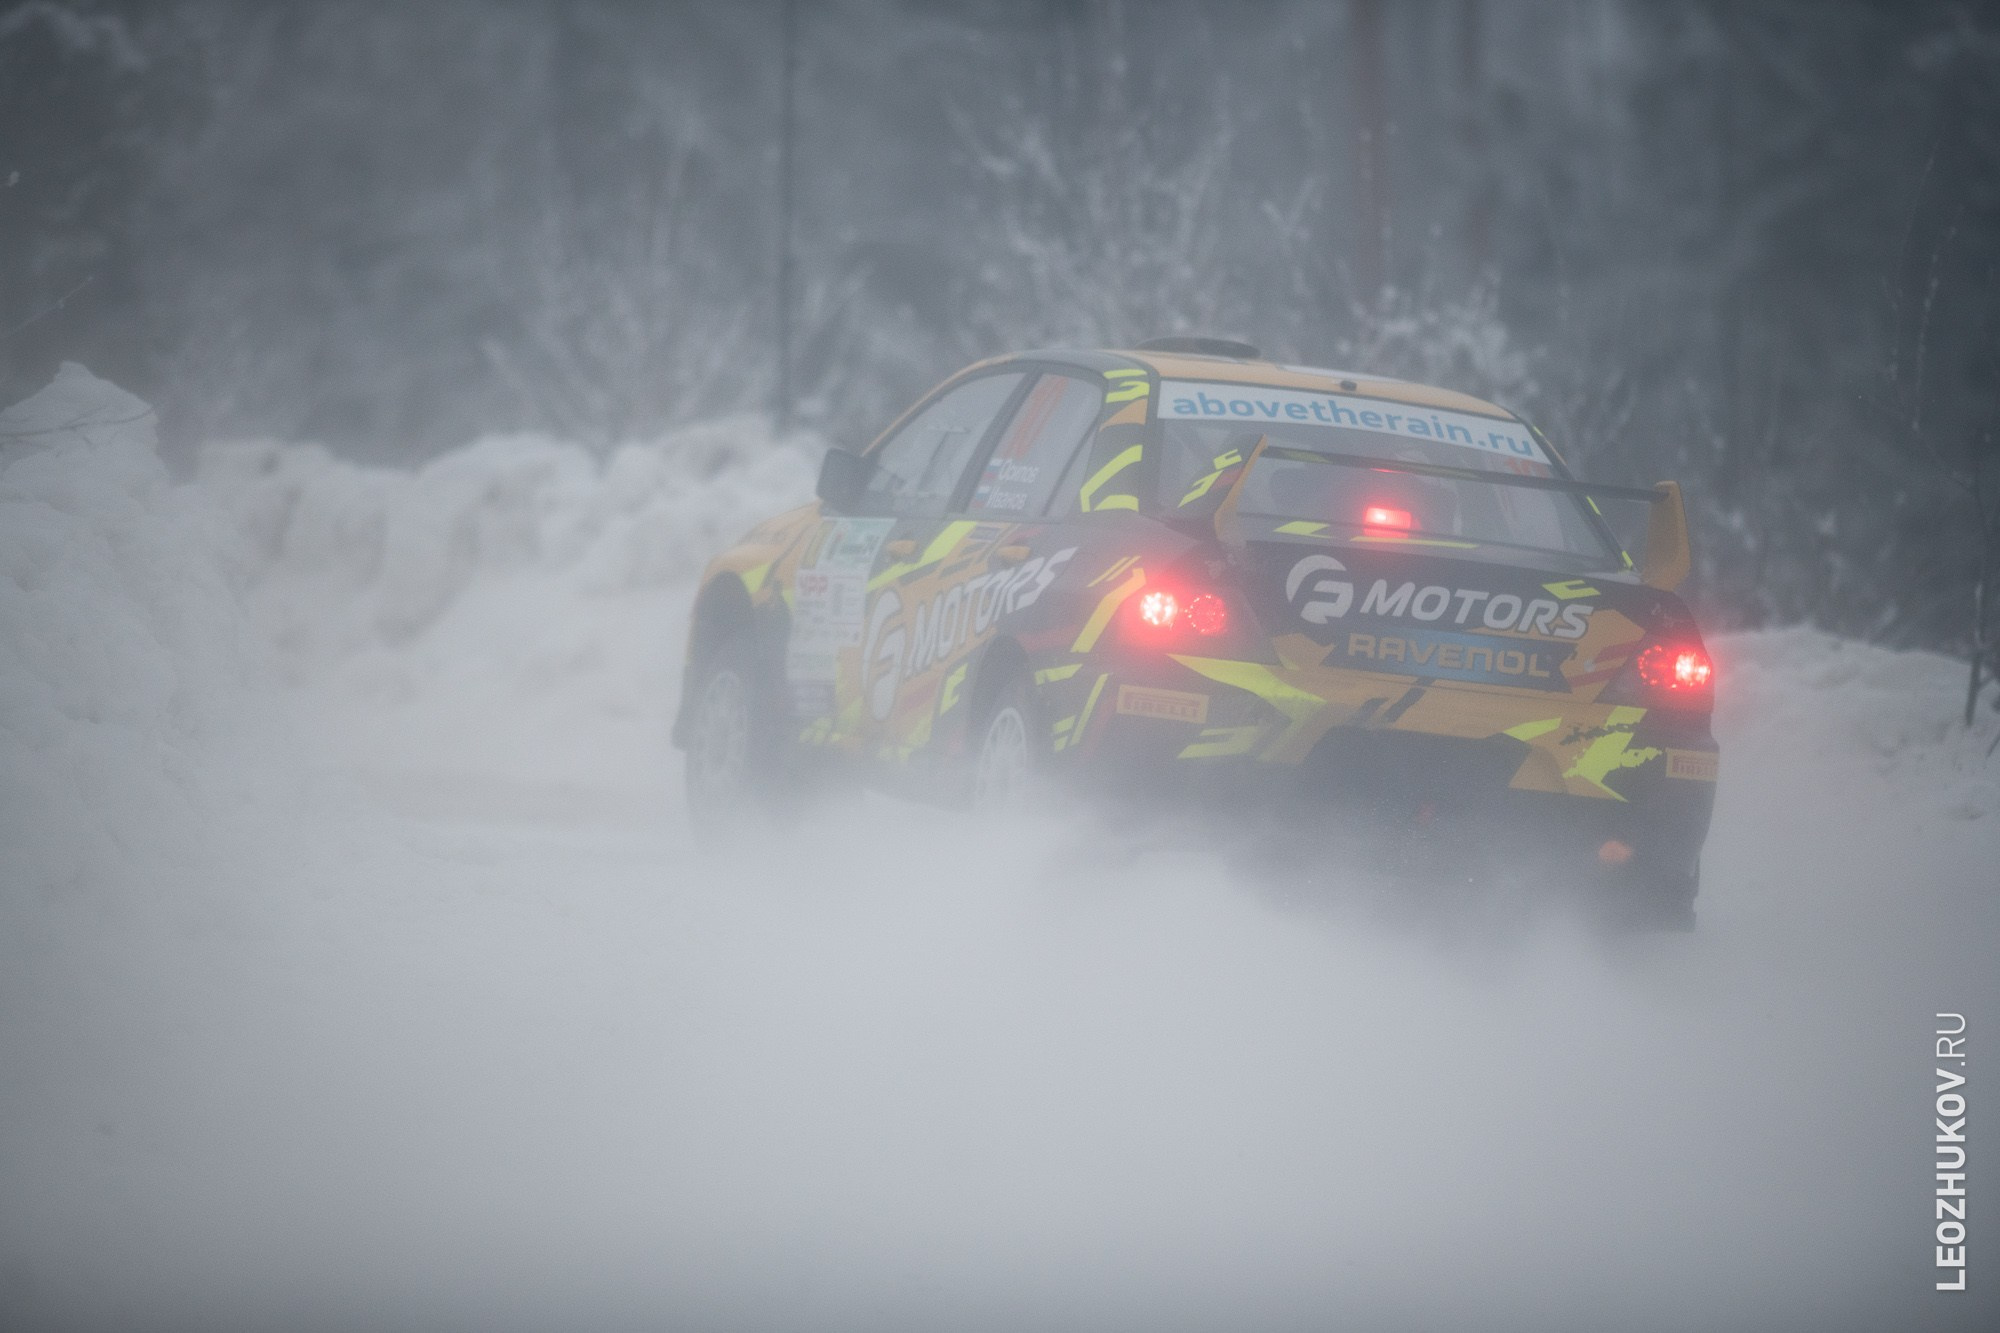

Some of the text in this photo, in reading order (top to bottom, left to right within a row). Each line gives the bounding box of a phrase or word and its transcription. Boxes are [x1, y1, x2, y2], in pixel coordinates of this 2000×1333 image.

[1173, 392, 1534, 458] abovetherain.ru
[906, 546, 1079, 680] MOTORS
[1359, 579, 1594, 639] MOTORS
[1123, 690, 1200, 717] PIRELLI
